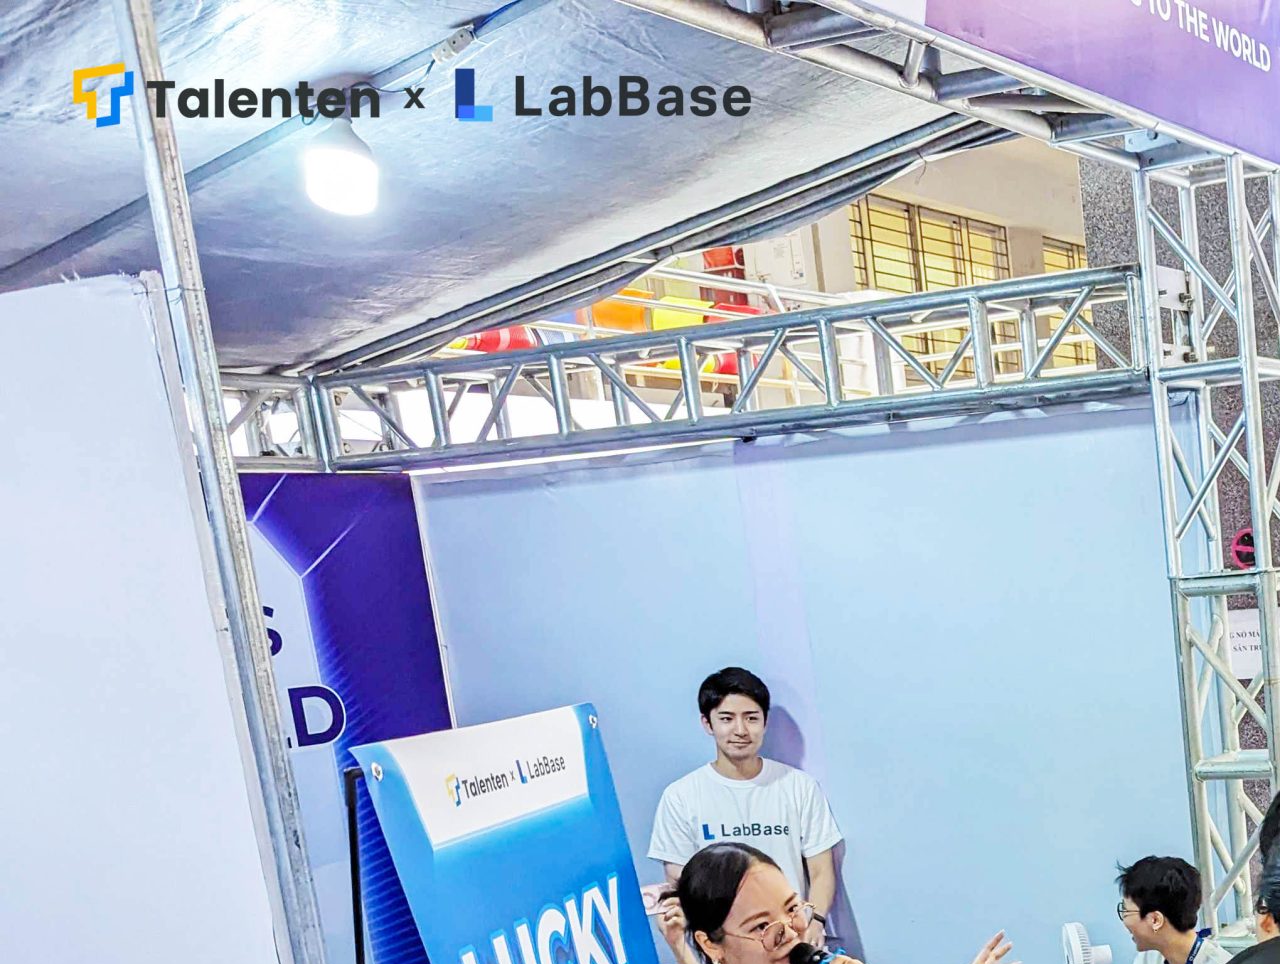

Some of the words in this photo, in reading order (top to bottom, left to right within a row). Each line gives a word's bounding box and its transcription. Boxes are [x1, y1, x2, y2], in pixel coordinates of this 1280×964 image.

[1174, 0, 1210, 42] THE
[1211, 17, 1271, 72] WORLD
[461, 772, 509, 799] Talenten
[526, 756, 566, 779] LabBase
[721, 823, 789, 837] LabBase
